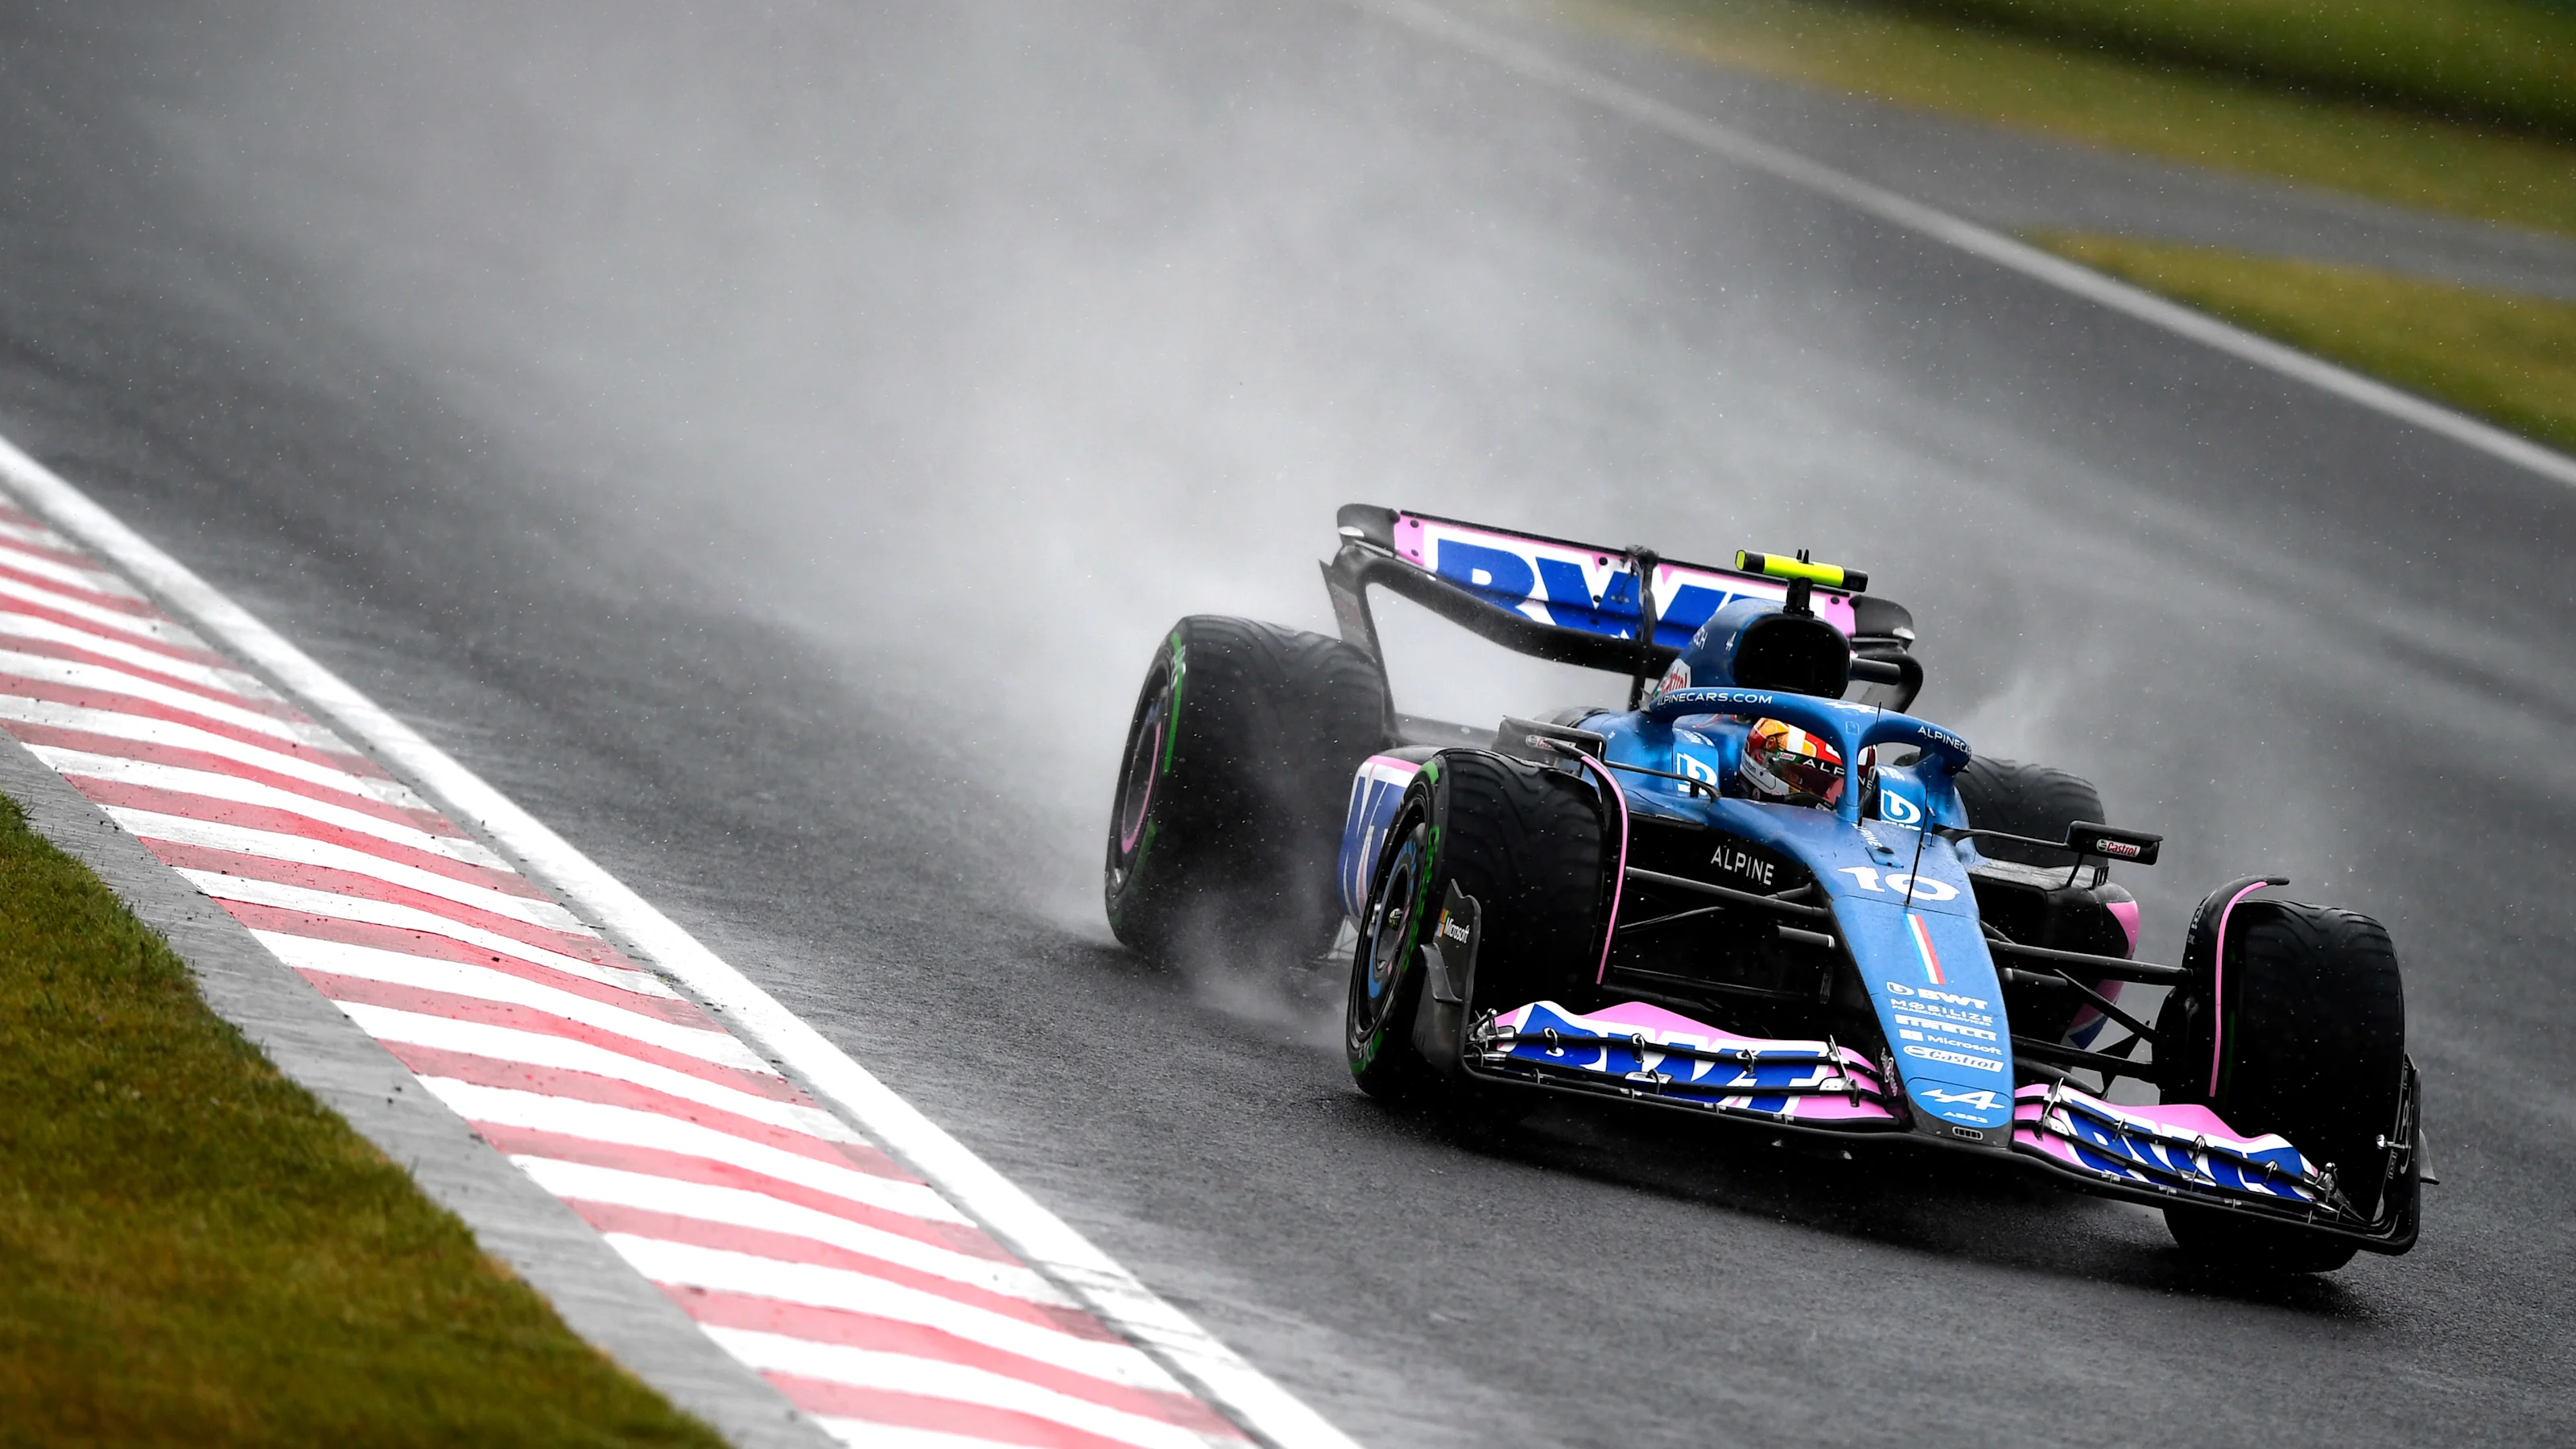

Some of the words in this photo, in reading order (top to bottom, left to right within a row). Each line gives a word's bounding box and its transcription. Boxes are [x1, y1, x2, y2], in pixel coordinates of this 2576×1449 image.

[1657, 692, 1773, 707] ALPINECARS.COM
[1802, 758, 1874, 791] ALPNE
[2107, 841, 2138, 857] Castrol
[1711, 845, 1774, 886] ALPINE
[1837, 866, 1961, 901] 10
[1443, 916, 1471, 944] Microsoft
[1917, 988, 1988, 1010] BWT
[1894, 1013, 1997, 1042] PIRELLI
[1926, 1034, 2003, 1055] Microsoft
[1929, 1050, 1996, 1069] Castrol
